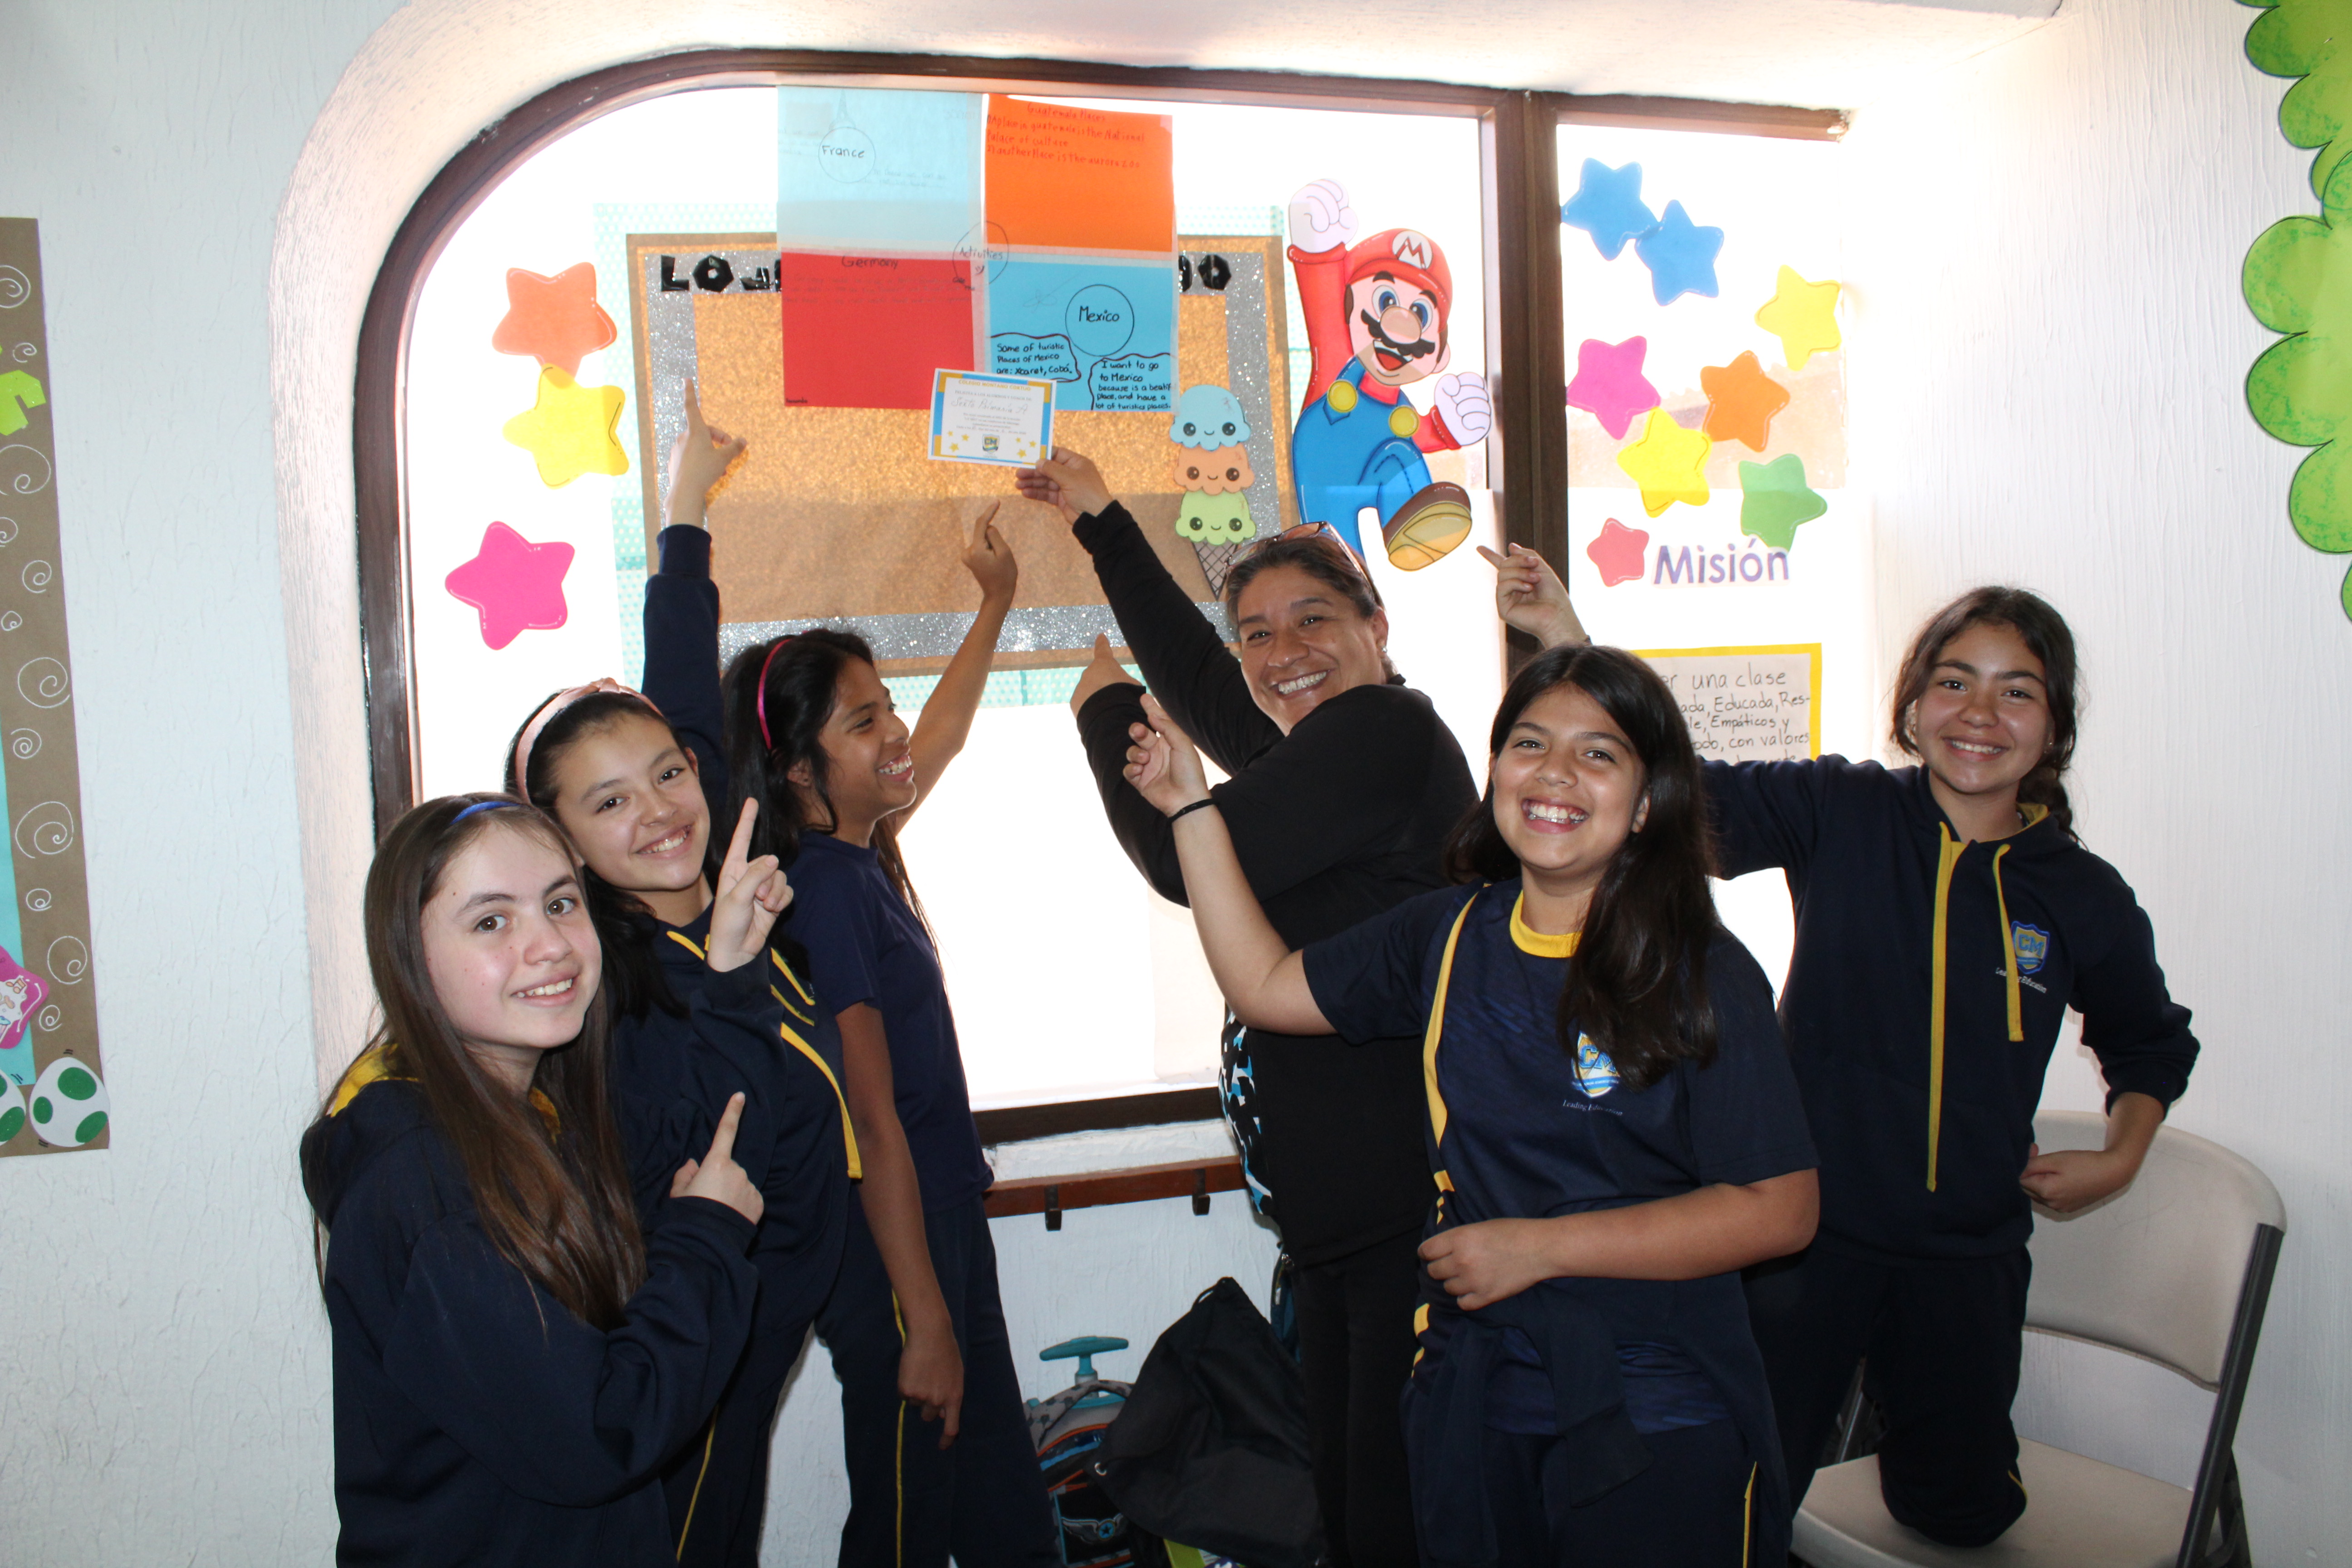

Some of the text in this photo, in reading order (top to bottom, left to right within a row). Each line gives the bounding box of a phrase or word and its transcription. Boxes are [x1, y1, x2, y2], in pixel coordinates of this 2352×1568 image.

[822, 145, 865, 158] France
[959, 245, 1003, 260] Activities
[1396, 236, 1426, 270] M
[842, 254, 898, 270] Germany
[1079, 306, 1119, 322] Mexico
[997, 343, 1019, 352] Some
[1023, 343, 1034, 352] of
[1034, 353, 1059, 361] Mexico
[1102, 360, 1159, 371] I want to go
[1100, 372, 1143, 382] to Mexico
[1654, 538, 1789, 584] Misión
[1661, 662, 1786, 690] er una clase
[1681, 691, 1810, 718] ada, Educada, Res-
[1710, 713, 1777, 735] Empáticos
[1782, 718, 1789, 734] y
[1729, 737, 1754, 749] con
[1760, 728, 1810, 746] valores
[2019, 934, 2044, 956] CM
[1578, 1044, 1617, 1074] CM
[1563, 1099, 1588, 1112] Leading
